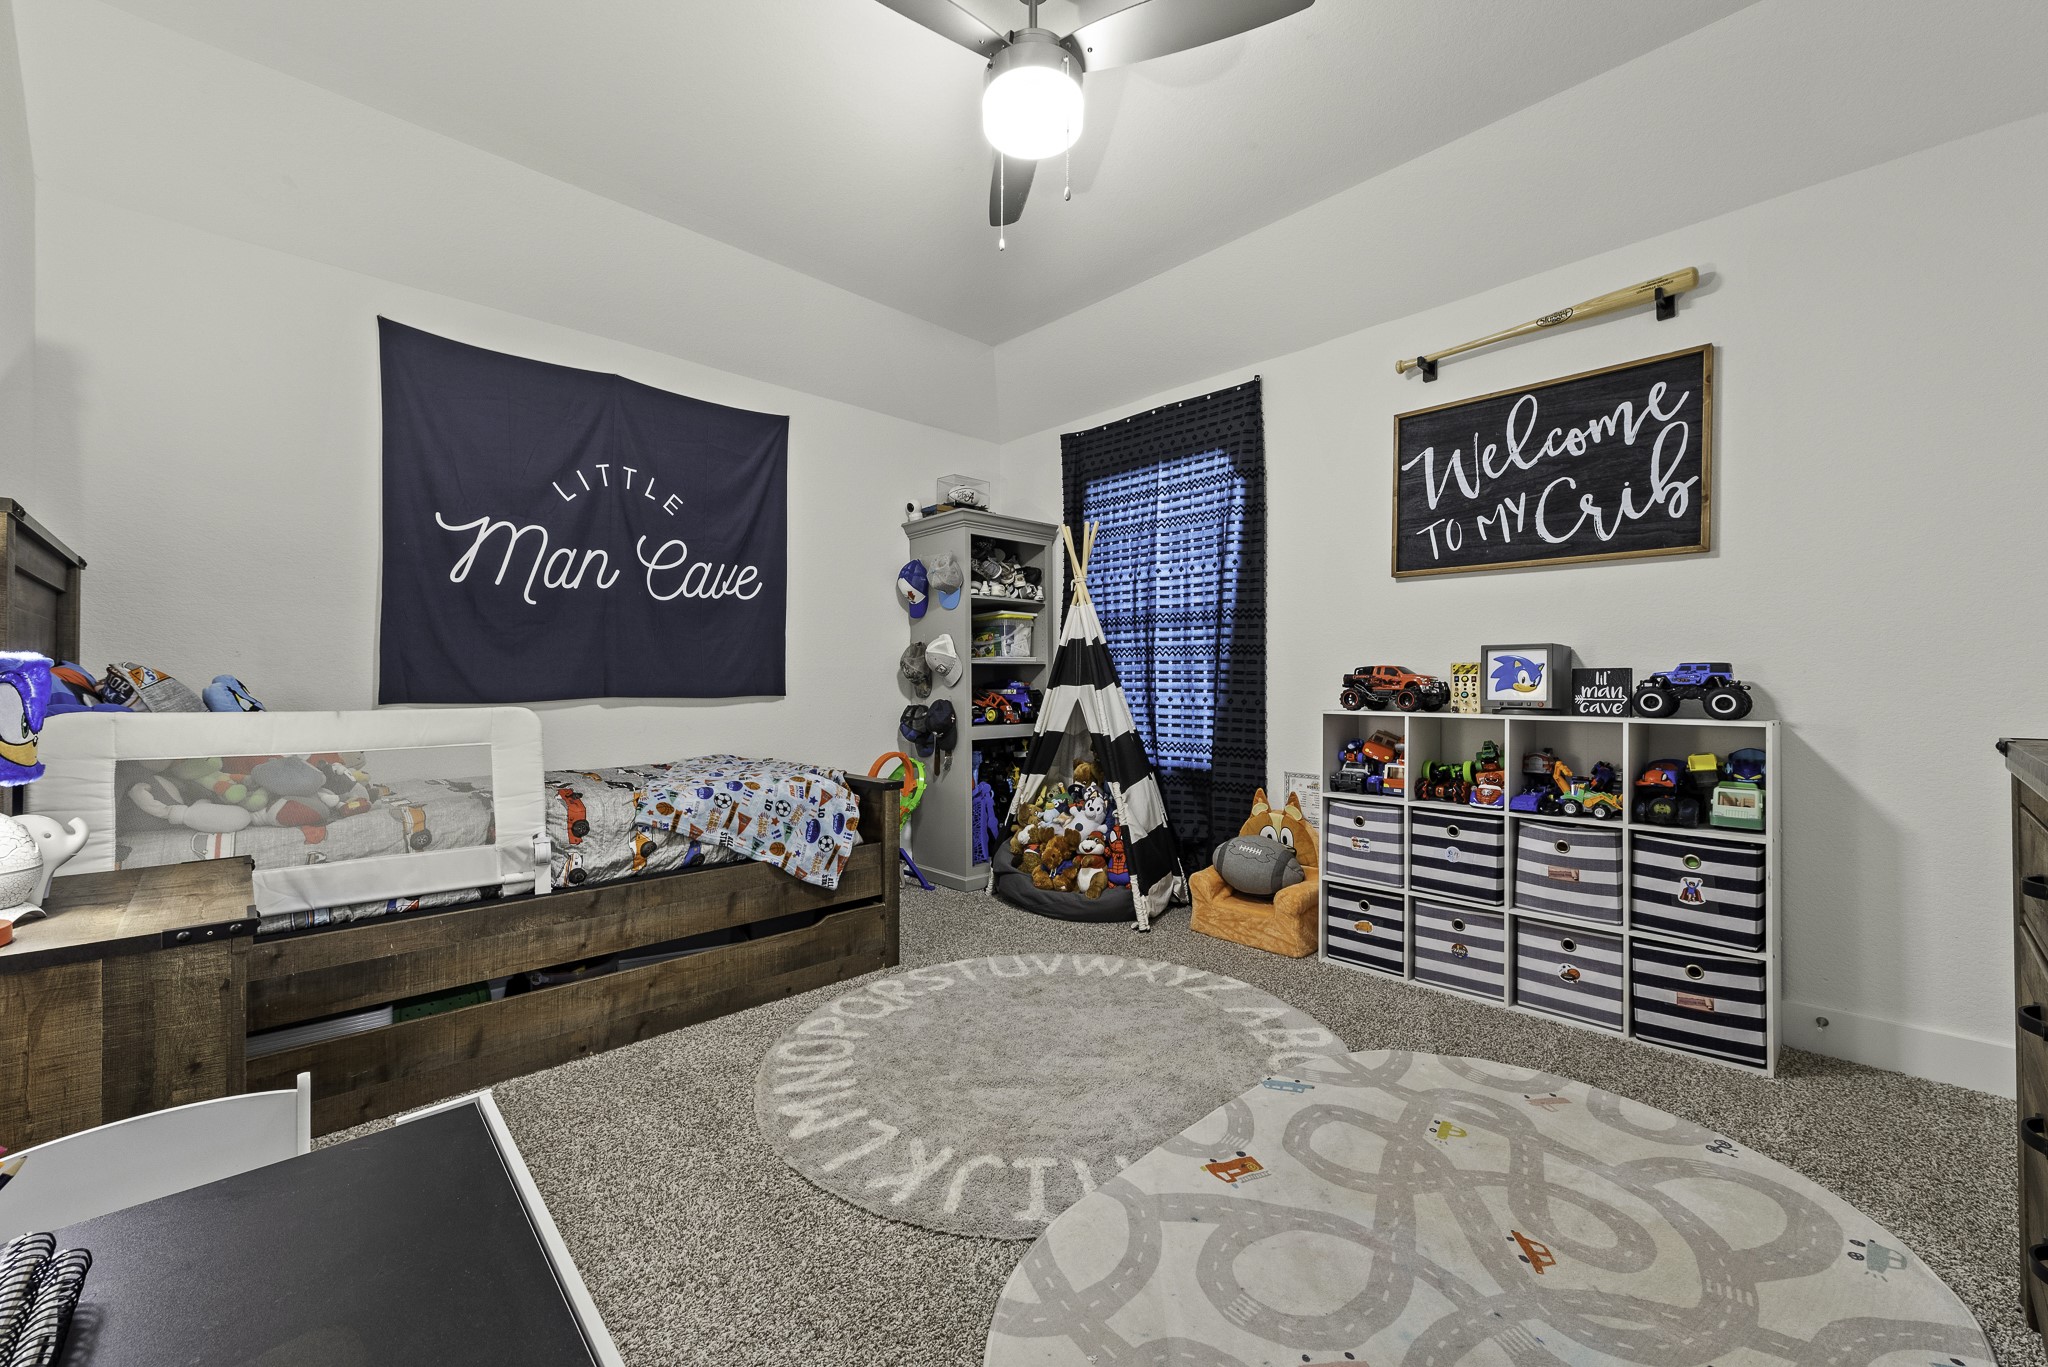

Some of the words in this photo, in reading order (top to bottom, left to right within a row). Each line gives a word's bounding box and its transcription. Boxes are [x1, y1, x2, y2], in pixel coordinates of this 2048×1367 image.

[1402, 381, 1690, 510] Welcome
[552, 463, 684, 516] LITTLE
[1416, 518, 1462, 560] TO
[1479, 492, 1527, 543] MY
[1535, 421, 1699, 544] Crib
[435, 511, 620, 605] Man
[636, 534, 762, 601] Cave
[1579, 702, 1623, 714] cave
[1581, 685, 1623, 699] man
[818, 807, 826, 818] 10
